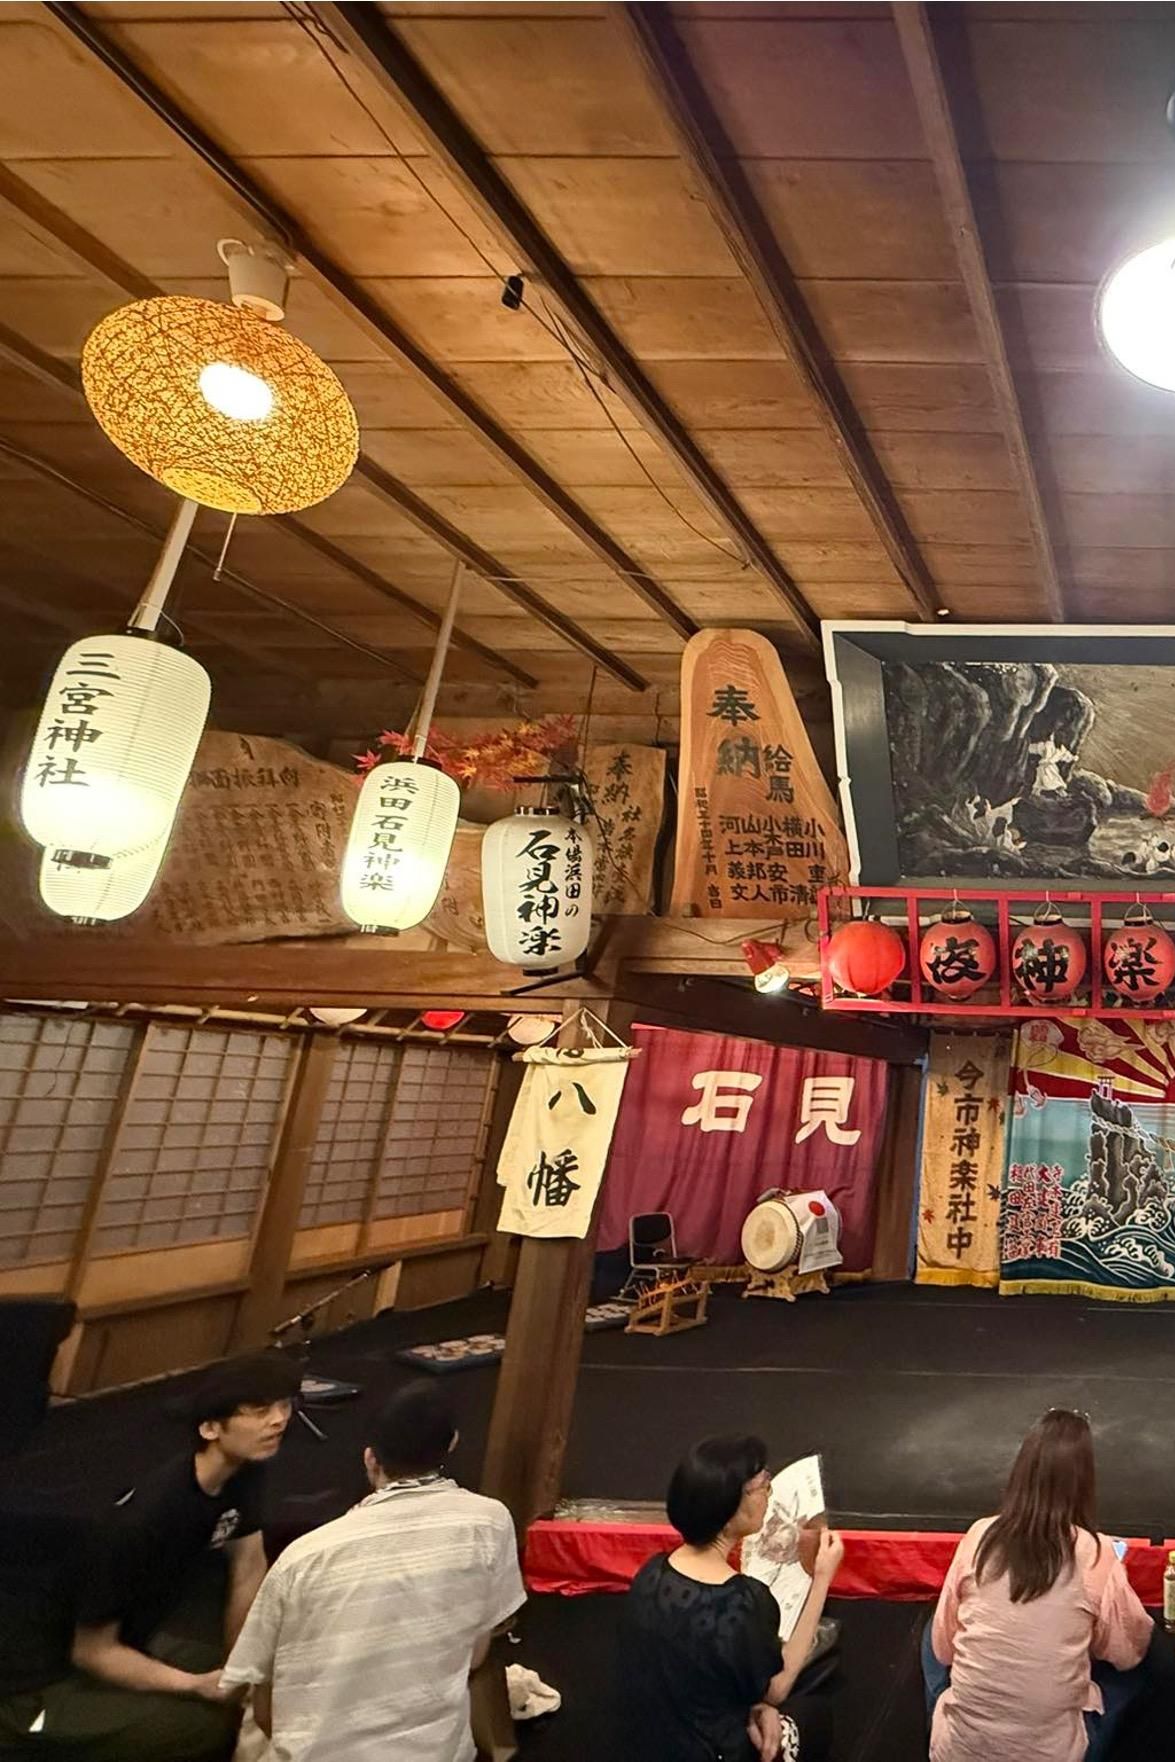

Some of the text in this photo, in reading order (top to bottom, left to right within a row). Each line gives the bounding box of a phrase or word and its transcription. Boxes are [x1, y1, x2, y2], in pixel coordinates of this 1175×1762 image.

[33, 652, 121, 788] 三宮神社
[707, 684, 761, 779] 奉納
[763, 744, 794, 804] 絵馬
[360, 776, 420, 892] 浜田石見神楽
[517, 830, 561, 956] 石見神楽
[528, 1081, 596, 1206] 八幡
[681, 1069, 862, 1146] 石見
[946, 1059, 984, 1260] 今市神楽社中
